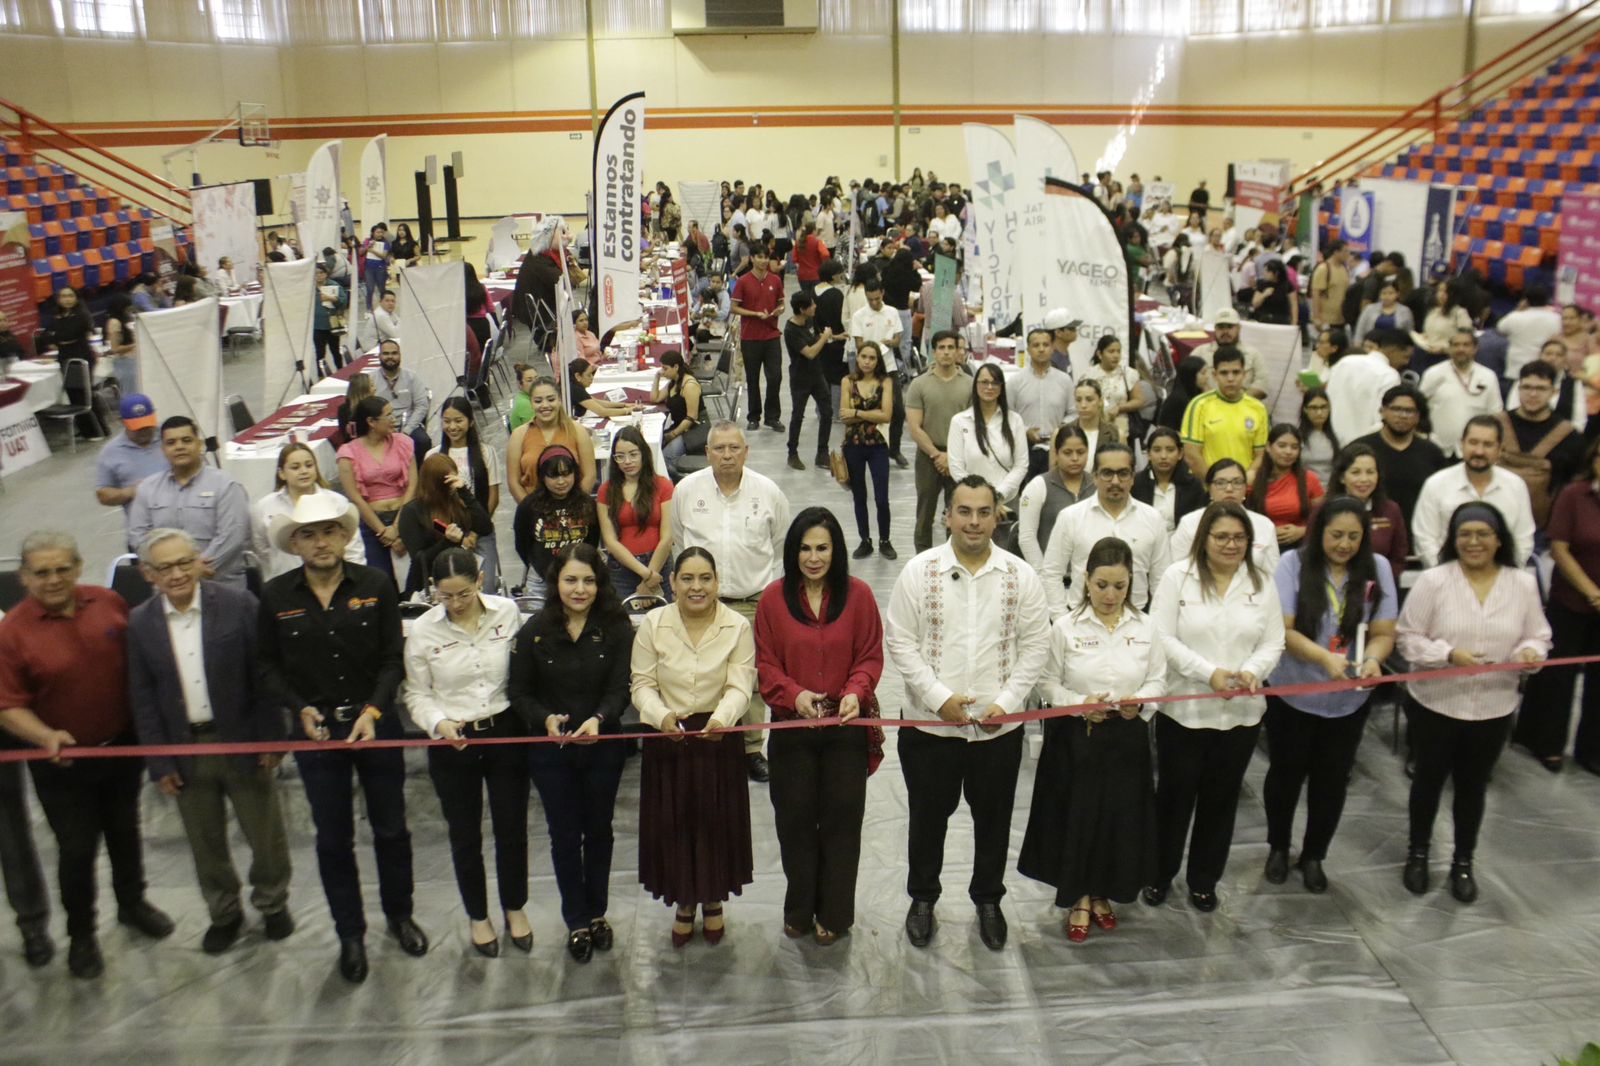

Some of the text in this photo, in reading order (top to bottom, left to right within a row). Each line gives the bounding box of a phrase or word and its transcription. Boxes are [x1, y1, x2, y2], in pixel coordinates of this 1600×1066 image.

[620, 109, 636, 262] contratando
[603, 154, 617, 259] Estamos
[1057, 259, 1119, 279] YAGEO
[1079, 324, 1116, 339] GEO
[5, 435, 30, 457] UAT
